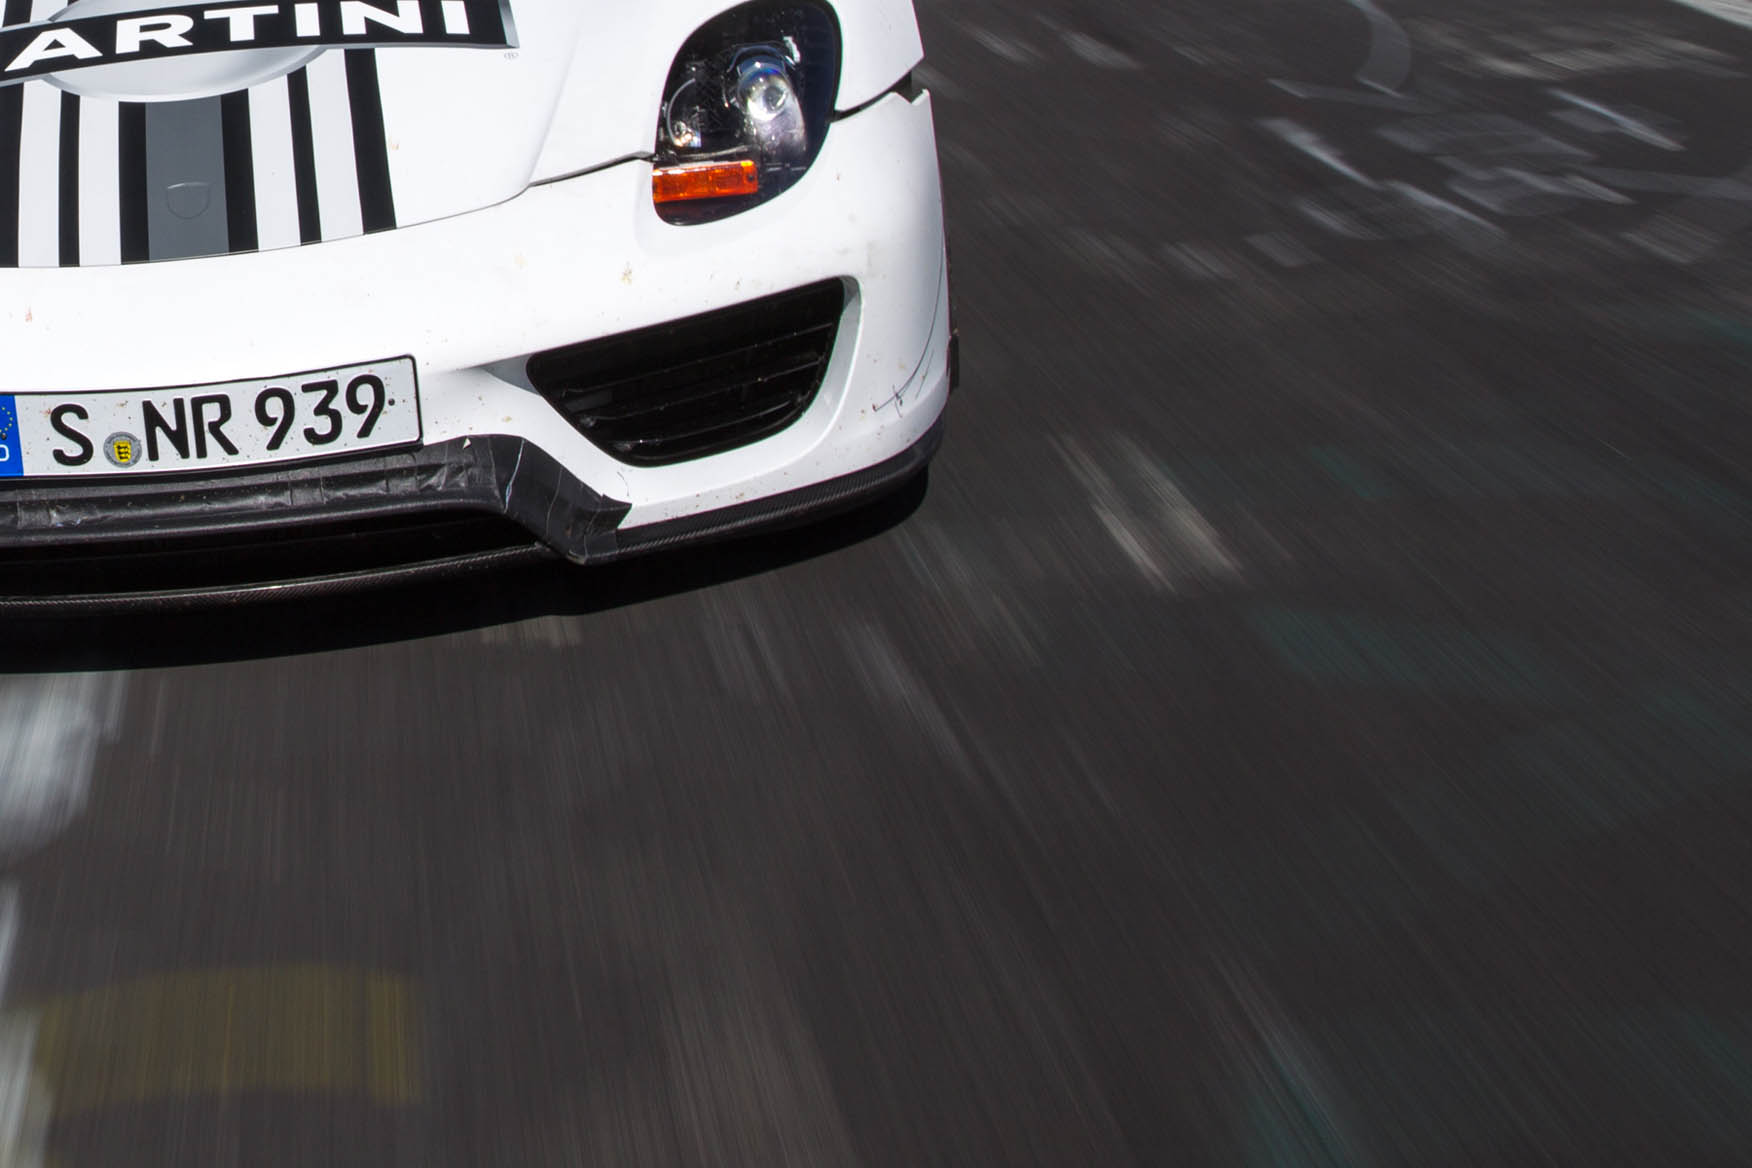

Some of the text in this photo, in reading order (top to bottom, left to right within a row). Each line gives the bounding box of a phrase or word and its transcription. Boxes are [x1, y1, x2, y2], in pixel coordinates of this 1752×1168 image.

[50, 374, 387, 467] S NR 939
